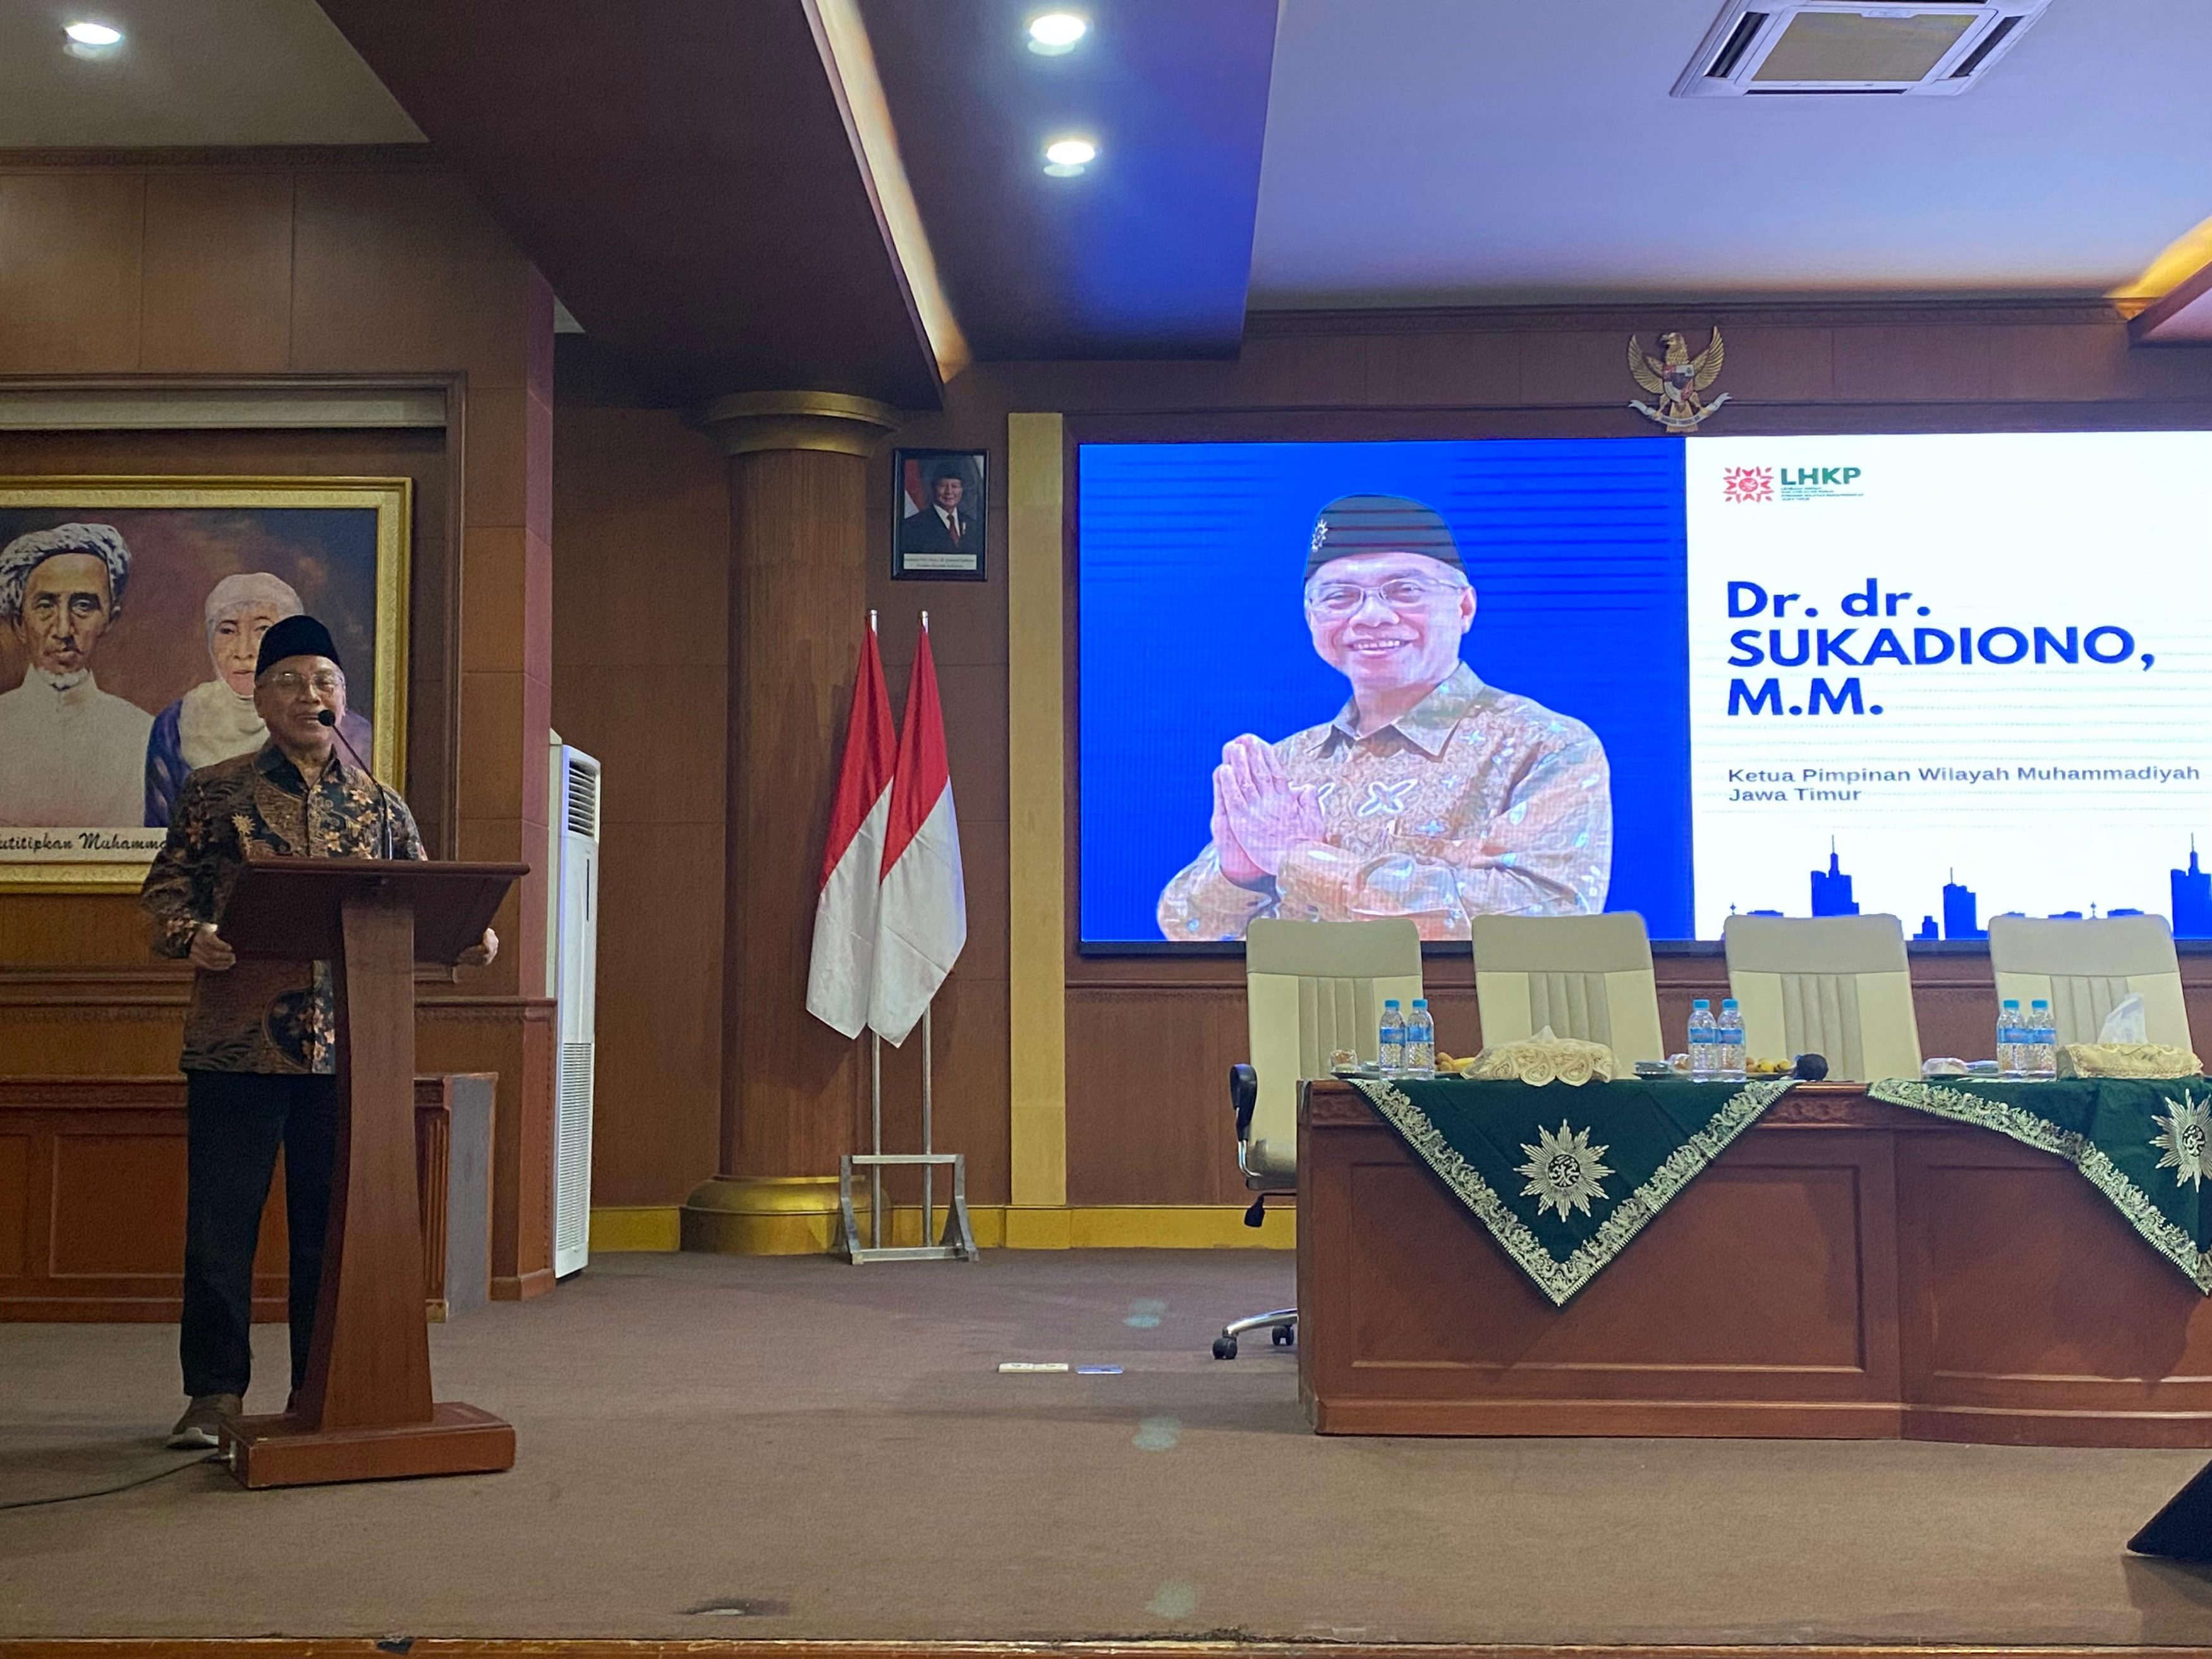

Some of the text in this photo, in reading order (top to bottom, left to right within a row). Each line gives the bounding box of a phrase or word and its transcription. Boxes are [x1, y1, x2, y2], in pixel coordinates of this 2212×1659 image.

[1780, 467, 1862, 485] LHKP
[1727, 578, 1931, 618] Dr. dr.
[1727, 626, 2155, 671] SUKADIONO,
[1727, 677, 1883, 716] M.M.
[1728, 765, 2200, 784] Ketua Pimpinan Wilayah Muhammadiyah
[1728, 788, 1862, 802] Jawa Timur
[0, 832, 73, 853] utitipkan
